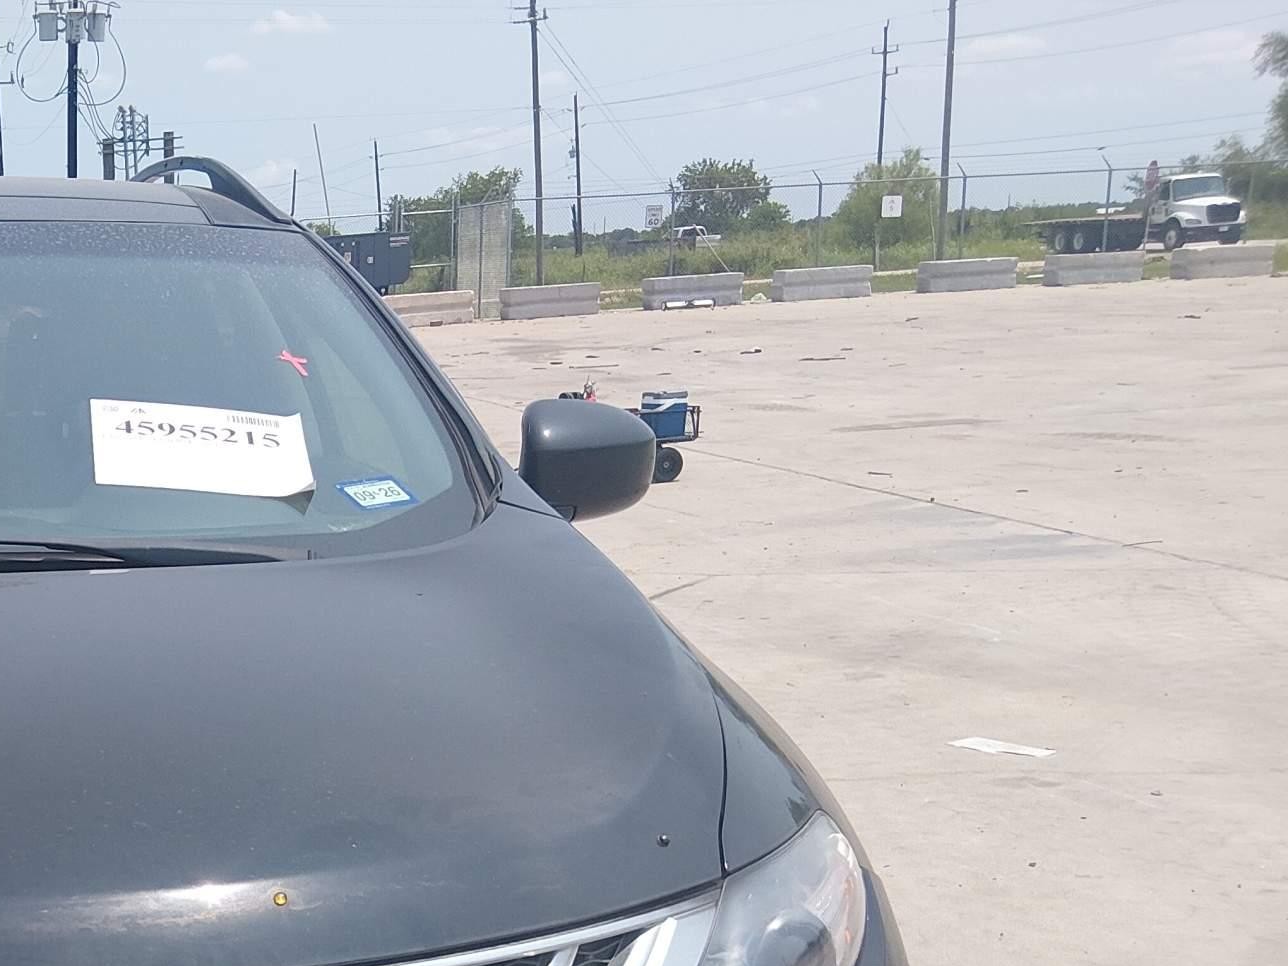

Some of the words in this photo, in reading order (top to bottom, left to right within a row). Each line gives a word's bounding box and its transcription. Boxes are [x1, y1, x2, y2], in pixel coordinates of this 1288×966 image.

[648, 218, 659, 226] 60
[115, 420, 281, 448] 45955215
[353, 490, 376, 502] 09
[378, 486, 401, 498] 26
